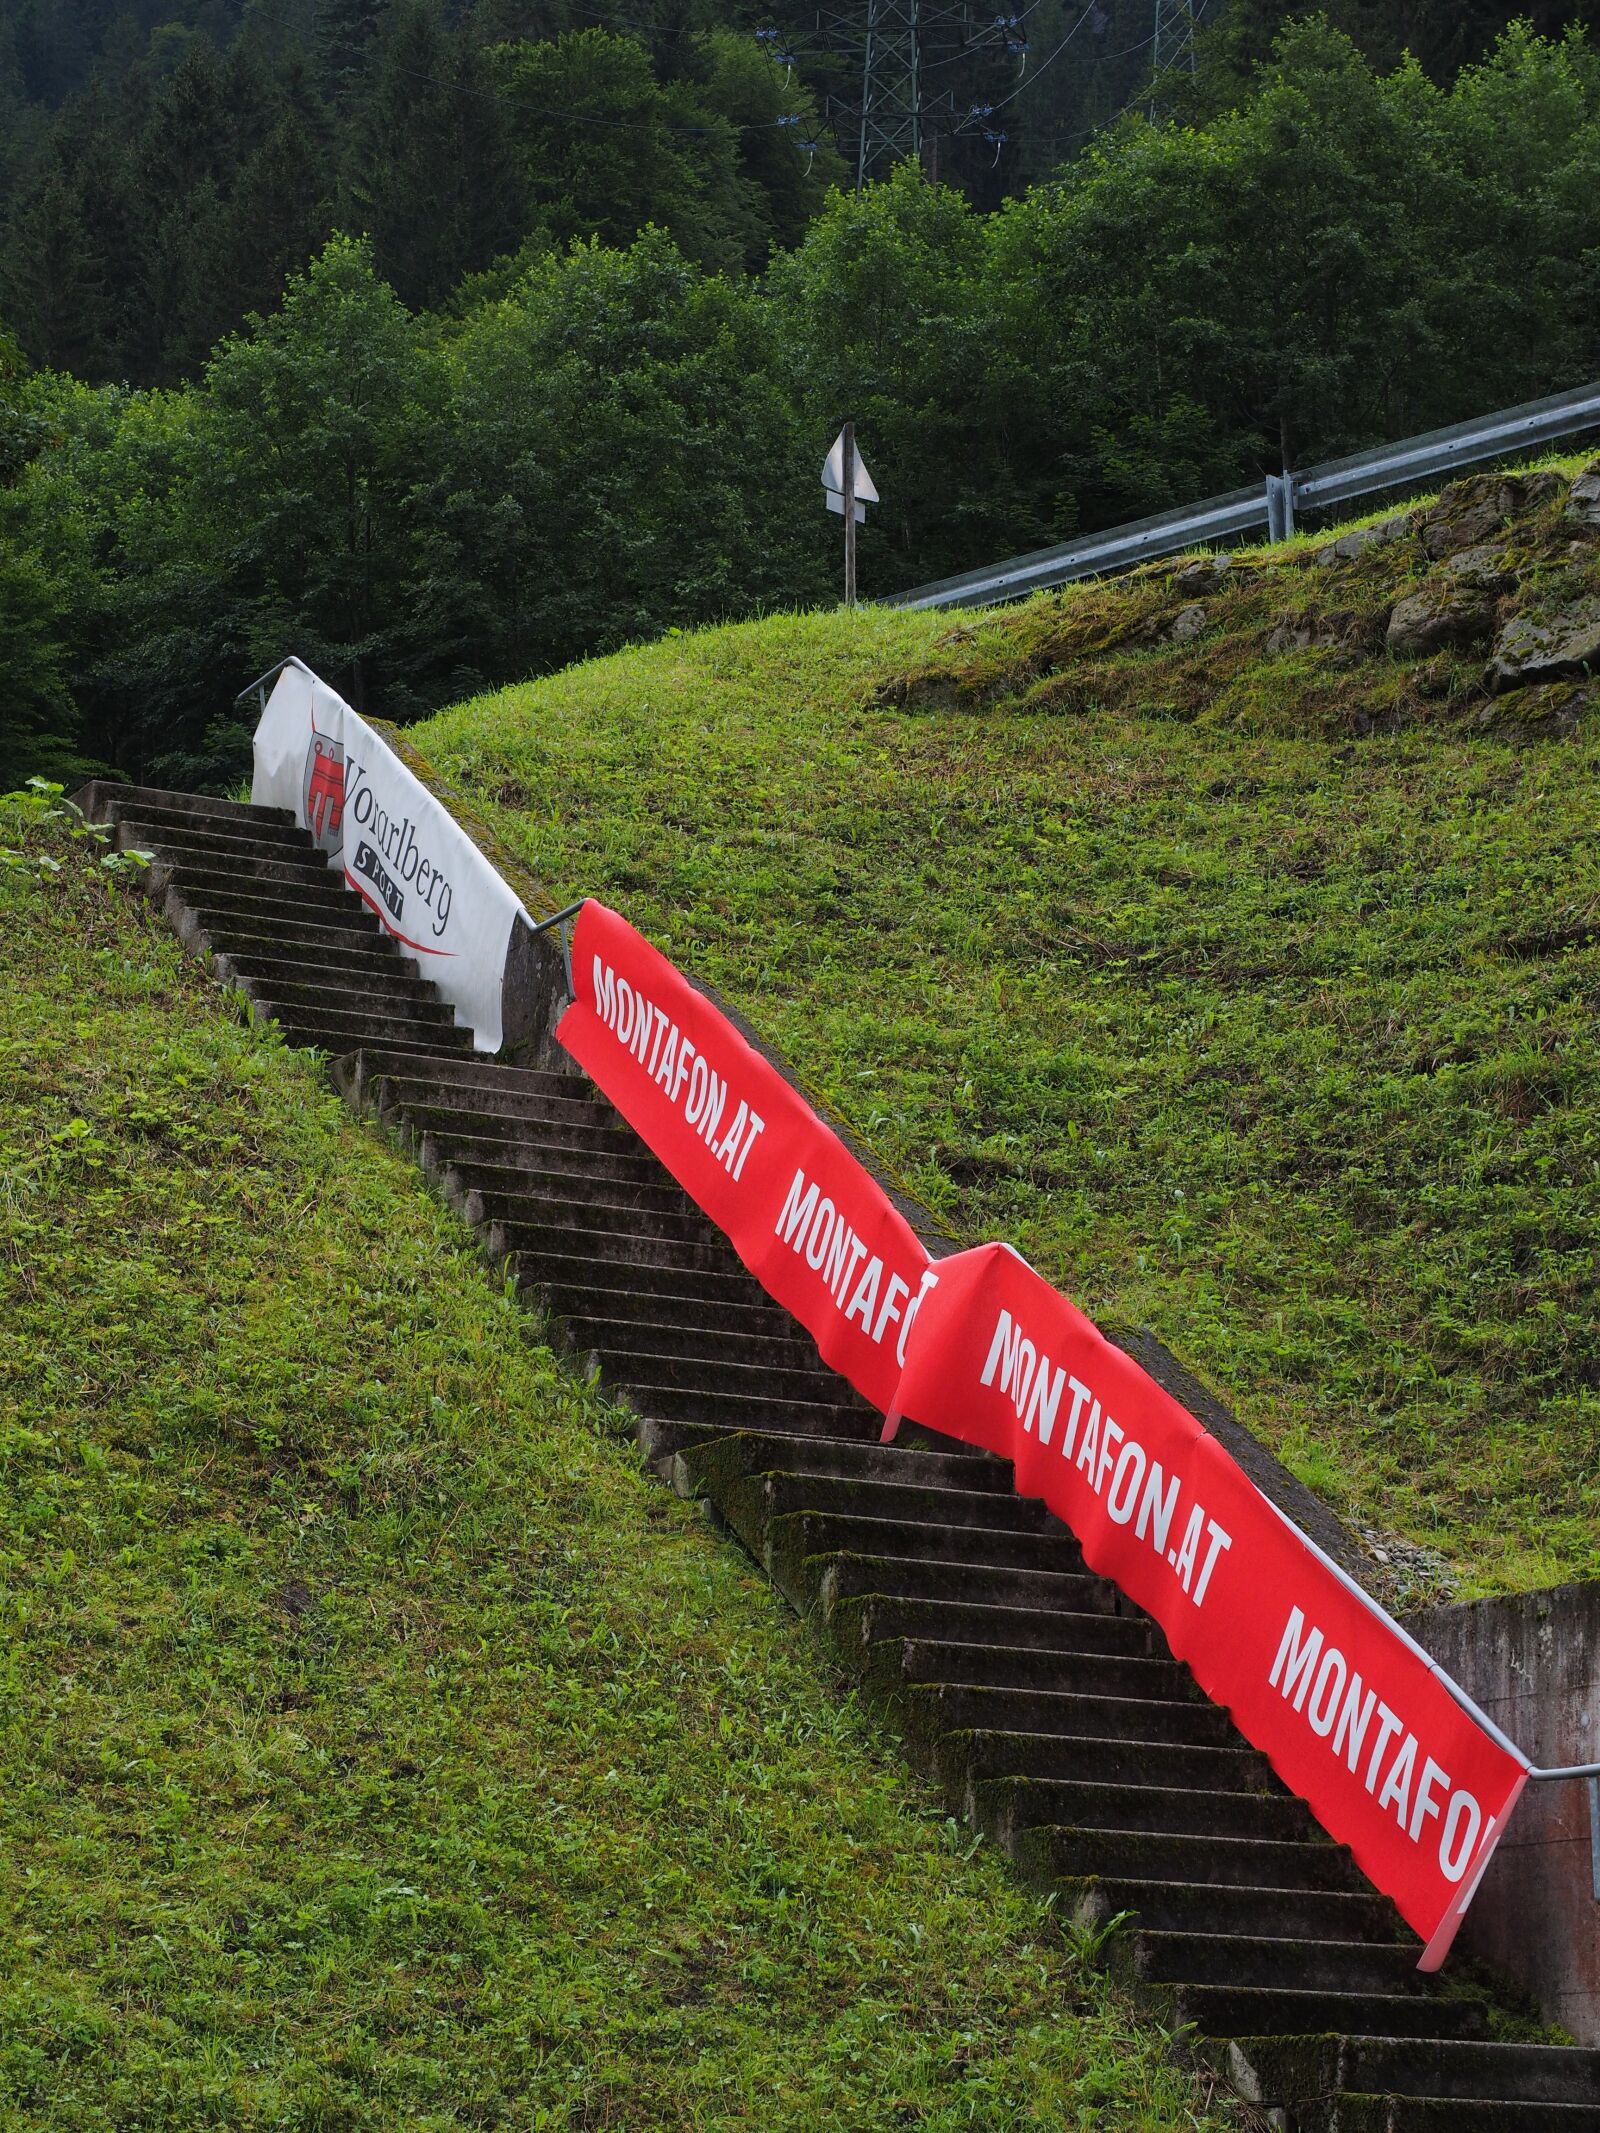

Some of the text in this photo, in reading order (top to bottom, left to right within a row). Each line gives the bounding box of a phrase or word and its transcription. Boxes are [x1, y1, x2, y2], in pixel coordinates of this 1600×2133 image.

[343, 755, 453, 937] Vorarlberg
[357, 846, 405, 918] SPORT
[593, 954, 765, 1182] MONTAFON.AT
[980, 1308, 1233, 1607] MONTAFON.AT
[1268, 1604, 1497, 1883] MONTAFO
